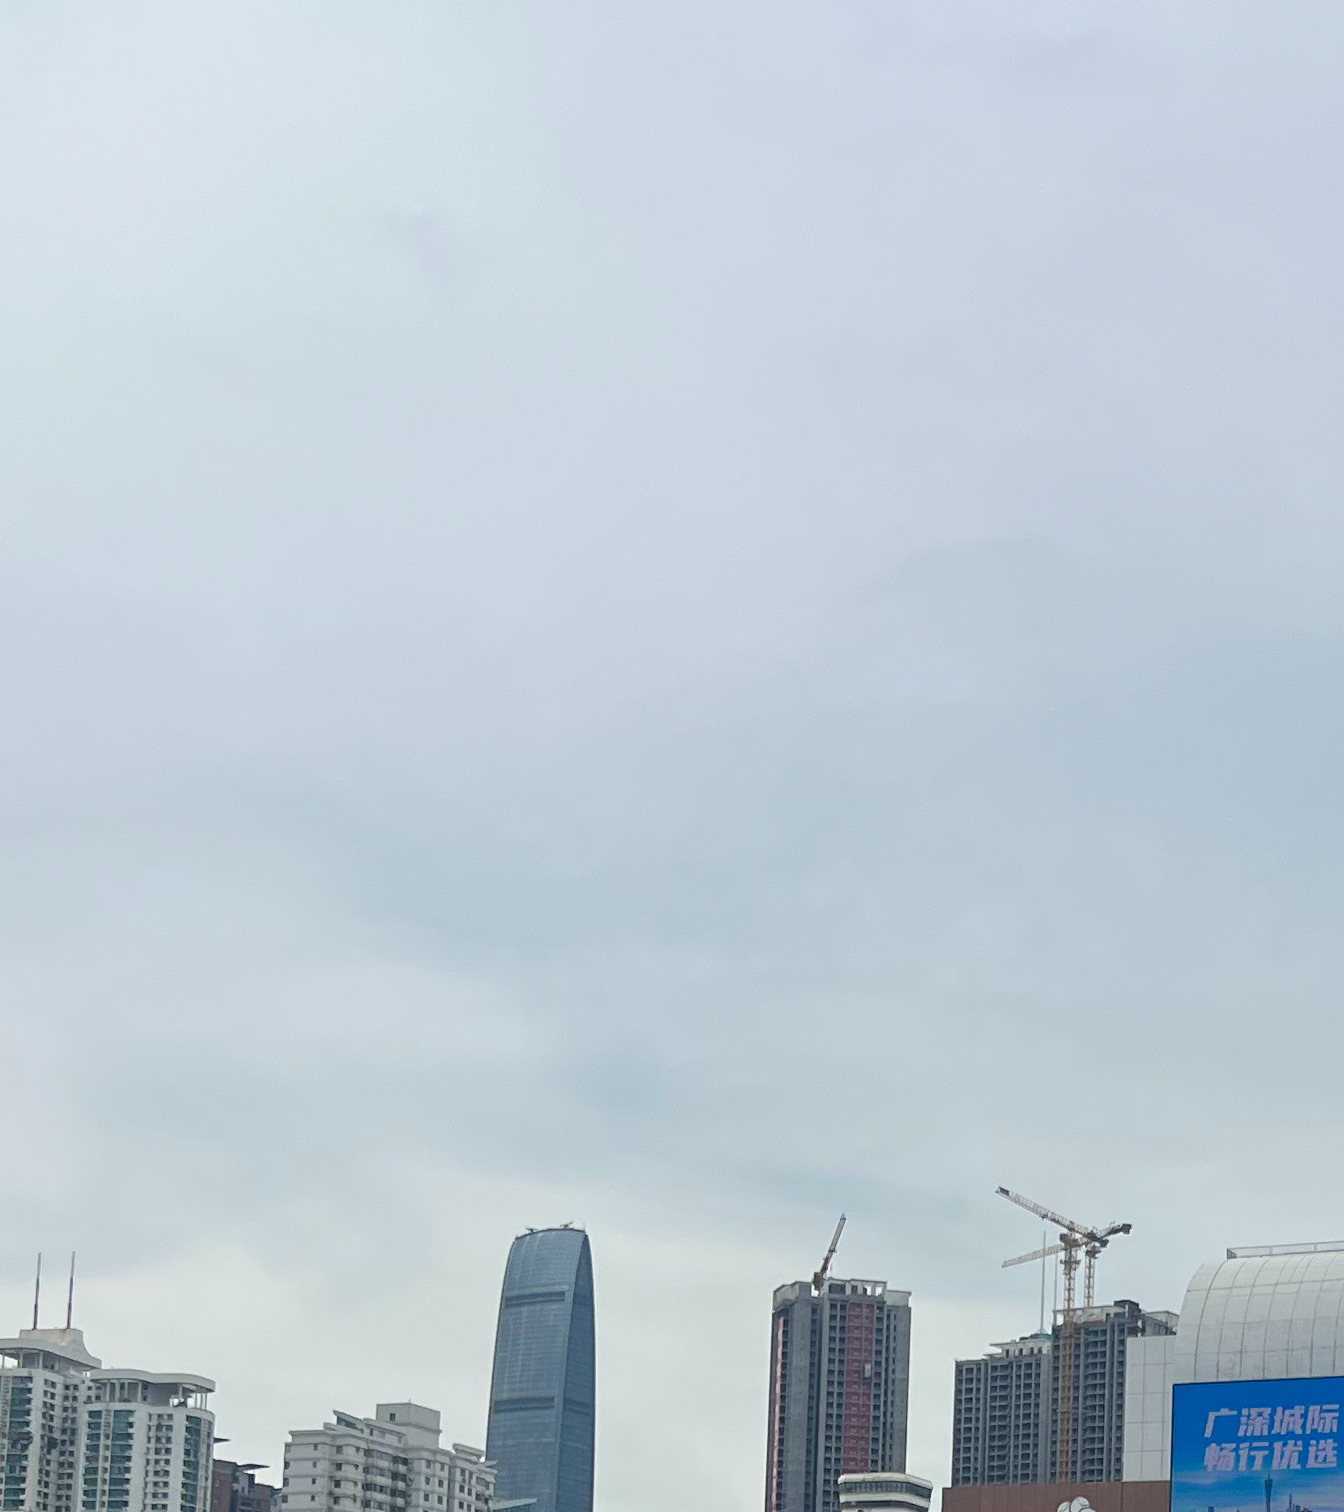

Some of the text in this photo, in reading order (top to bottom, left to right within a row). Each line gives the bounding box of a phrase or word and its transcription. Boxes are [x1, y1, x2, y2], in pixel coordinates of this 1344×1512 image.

[1204, 1404, 1340, 1438] 广深城际
[1204, 1438, 1338, 1472] 畅行优选
